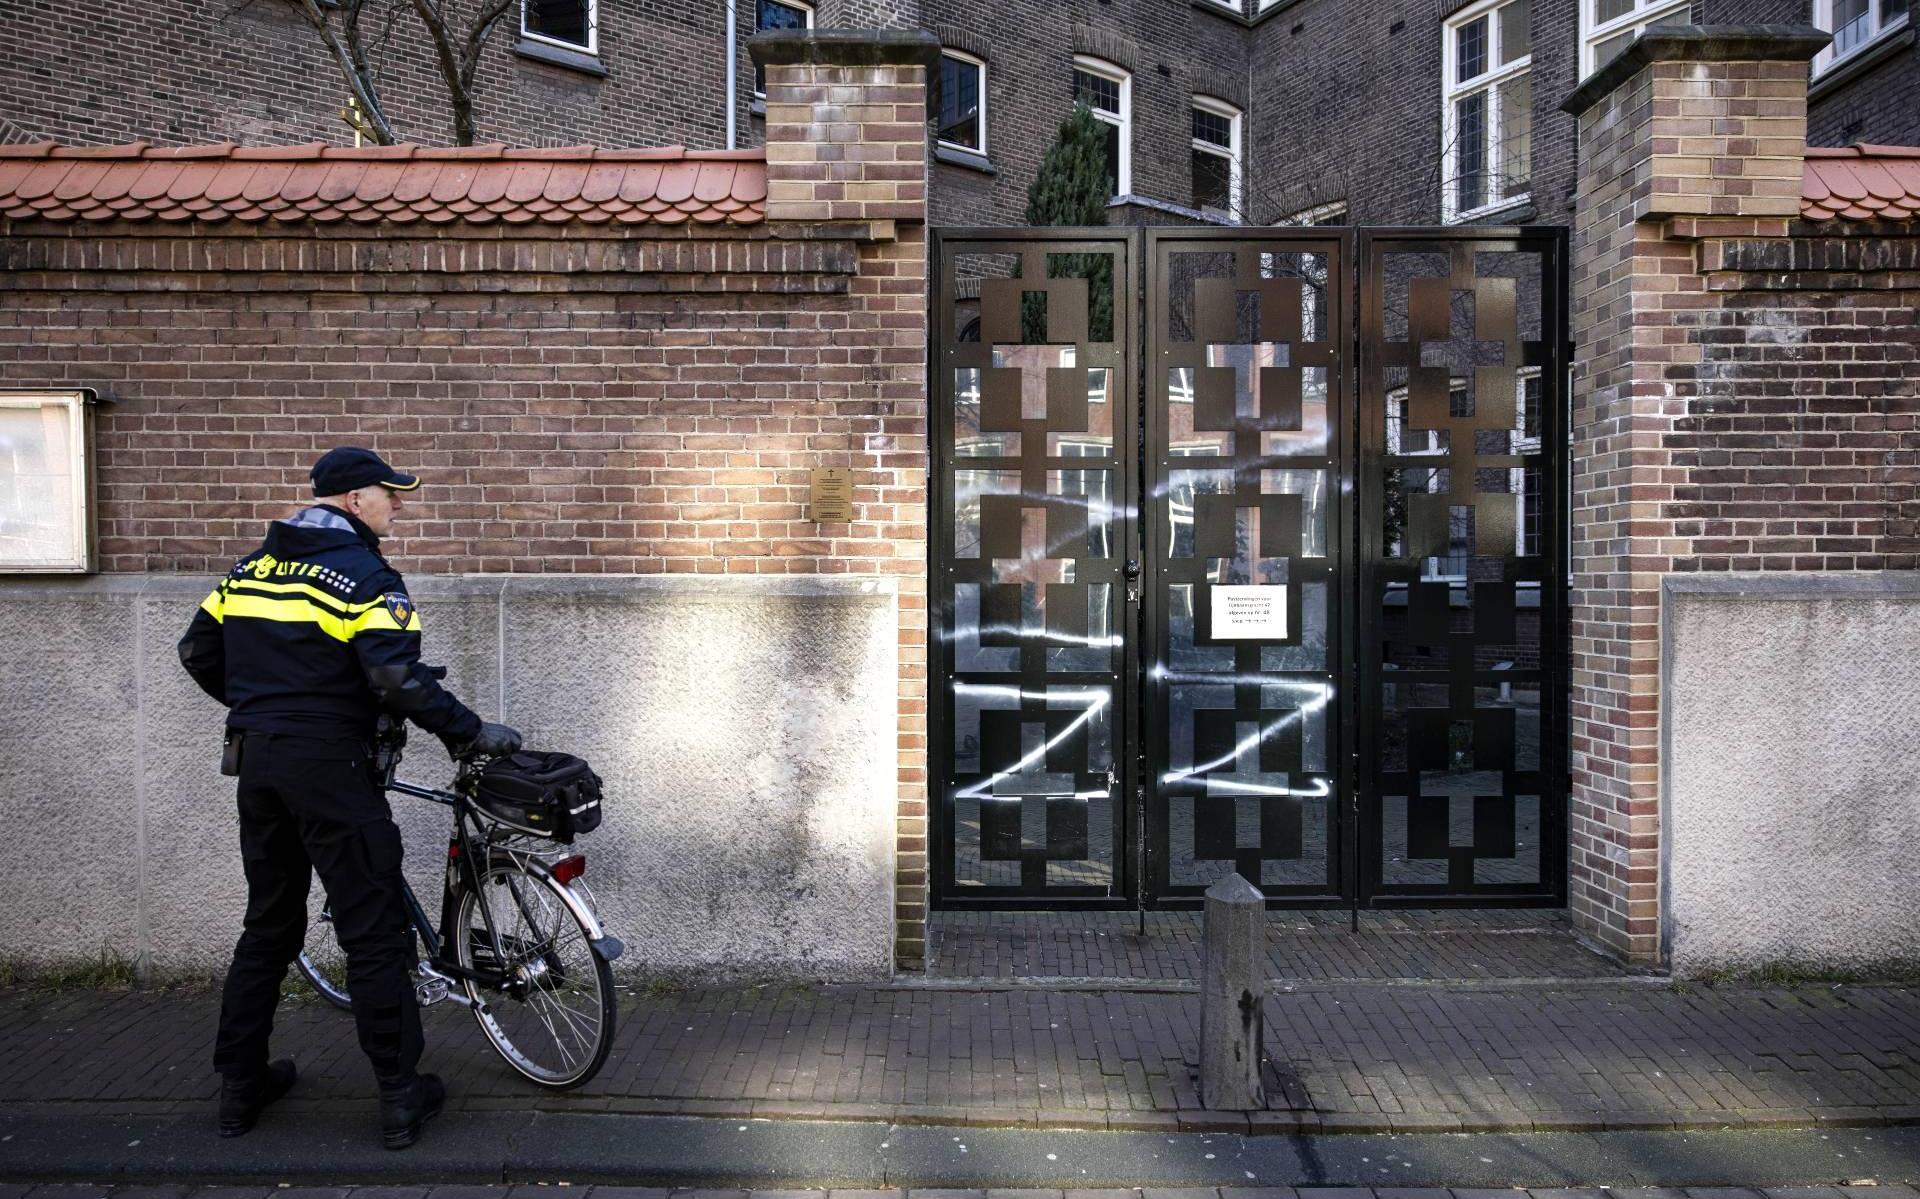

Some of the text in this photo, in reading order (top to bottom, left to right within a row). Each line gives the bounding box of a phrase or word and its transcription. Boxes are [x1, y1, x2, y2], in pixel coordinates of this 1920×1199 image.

[244, 555, 323, 579] POLITIE
[953, 664, 1336, 800] Z Z
